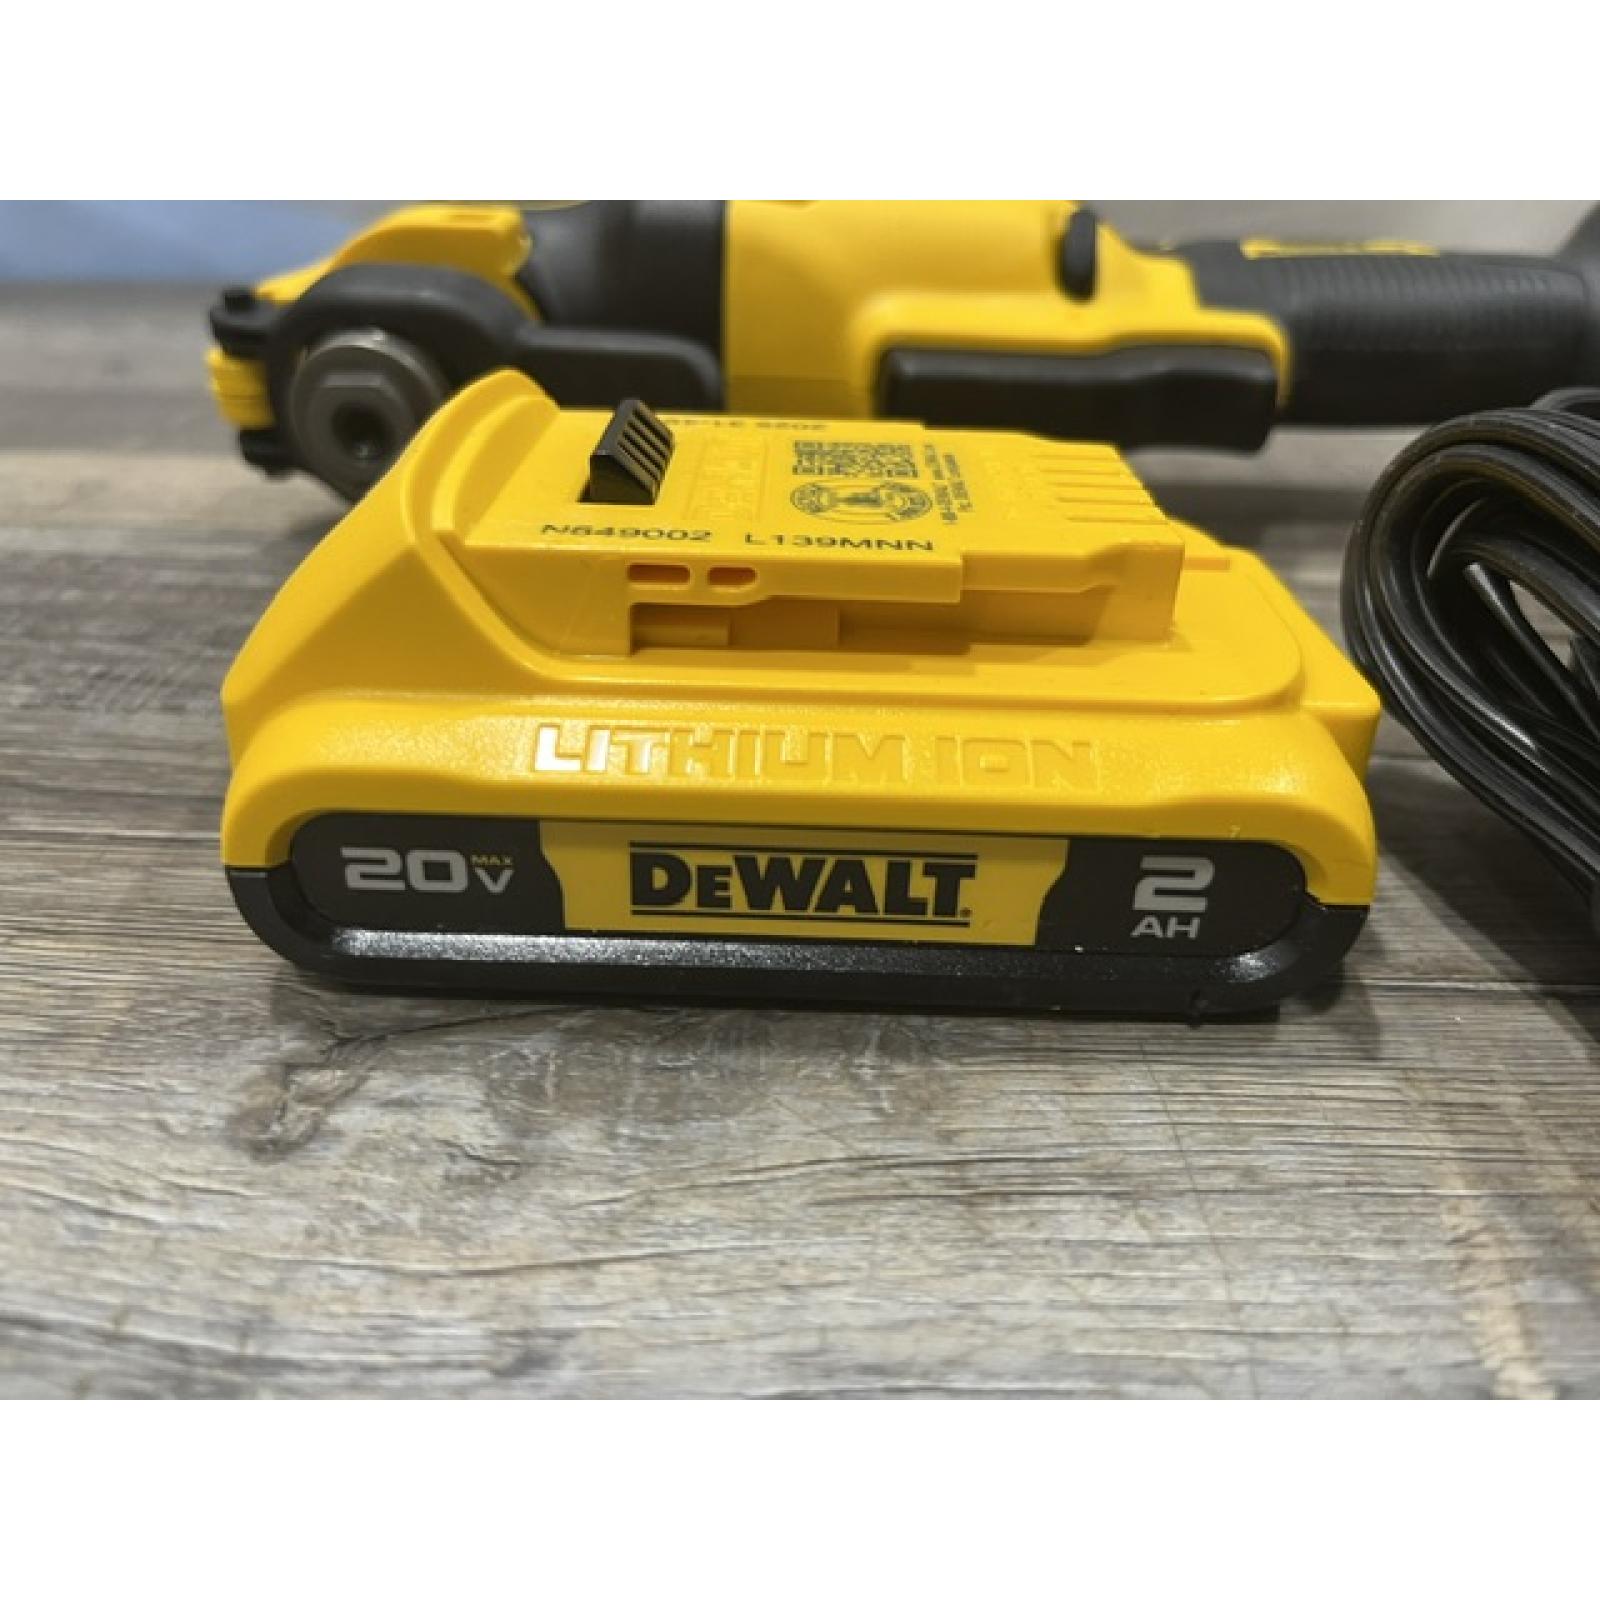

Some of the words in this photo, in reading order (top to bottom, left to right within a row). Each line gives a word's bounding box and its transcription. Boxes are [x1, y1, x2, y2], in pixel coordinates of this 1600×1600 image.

[534, 723, 905, 786] LITHIUM
[933, 735, 1099, 790] ION
[1133, 856, 1215, 912] 2
[1130, 915, 1201, 938] AH
